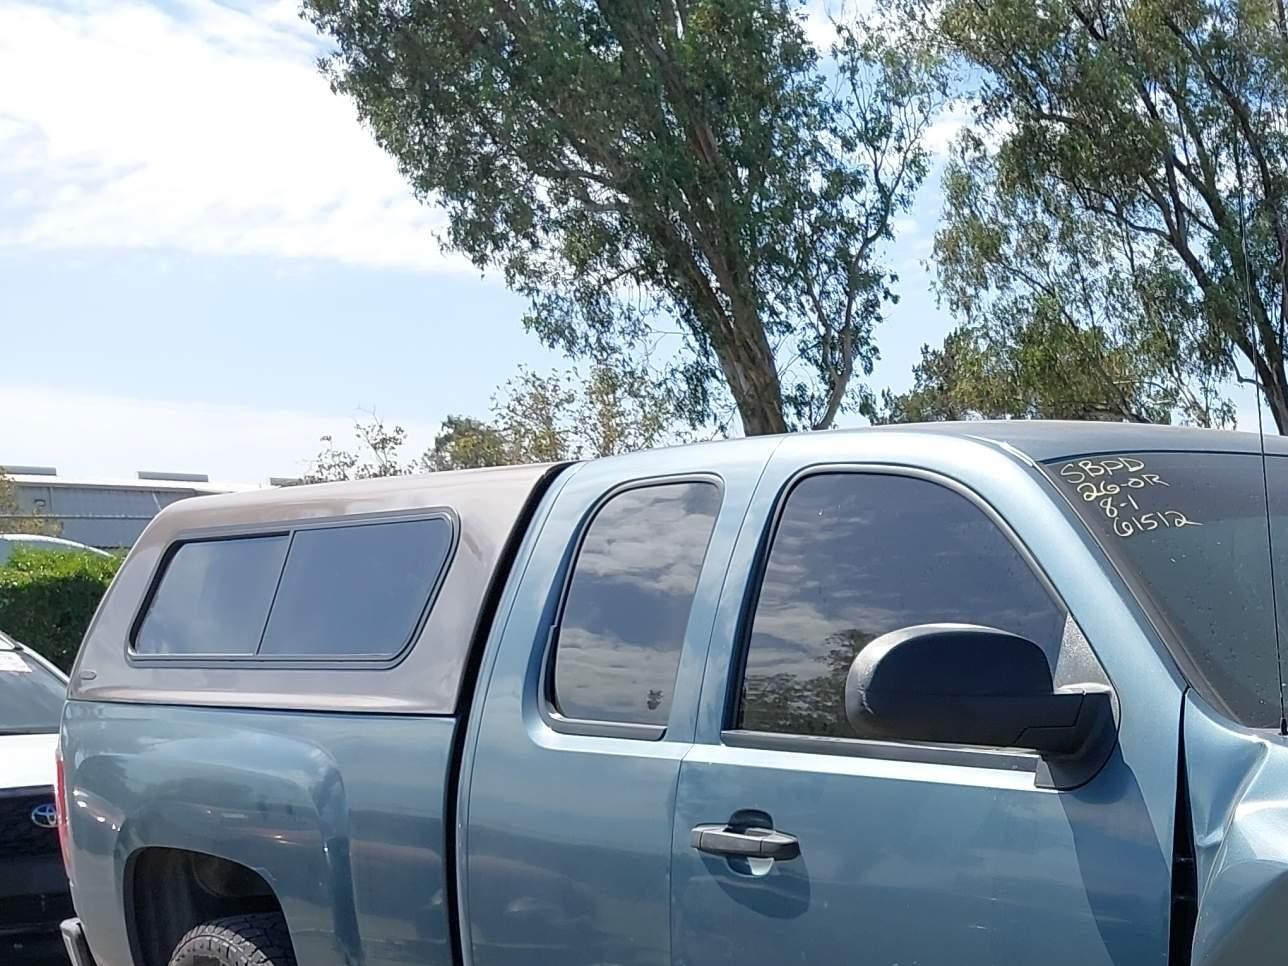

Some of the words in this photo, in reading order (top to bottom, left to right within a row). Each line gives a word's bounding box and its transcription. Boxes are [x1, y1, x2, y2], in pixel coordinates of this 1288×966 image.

[1060, 457, 1144, 484] SBPD
[1099, 494, 1139, 518] 8-1
[1113, 510, 1205, 537] 61512
